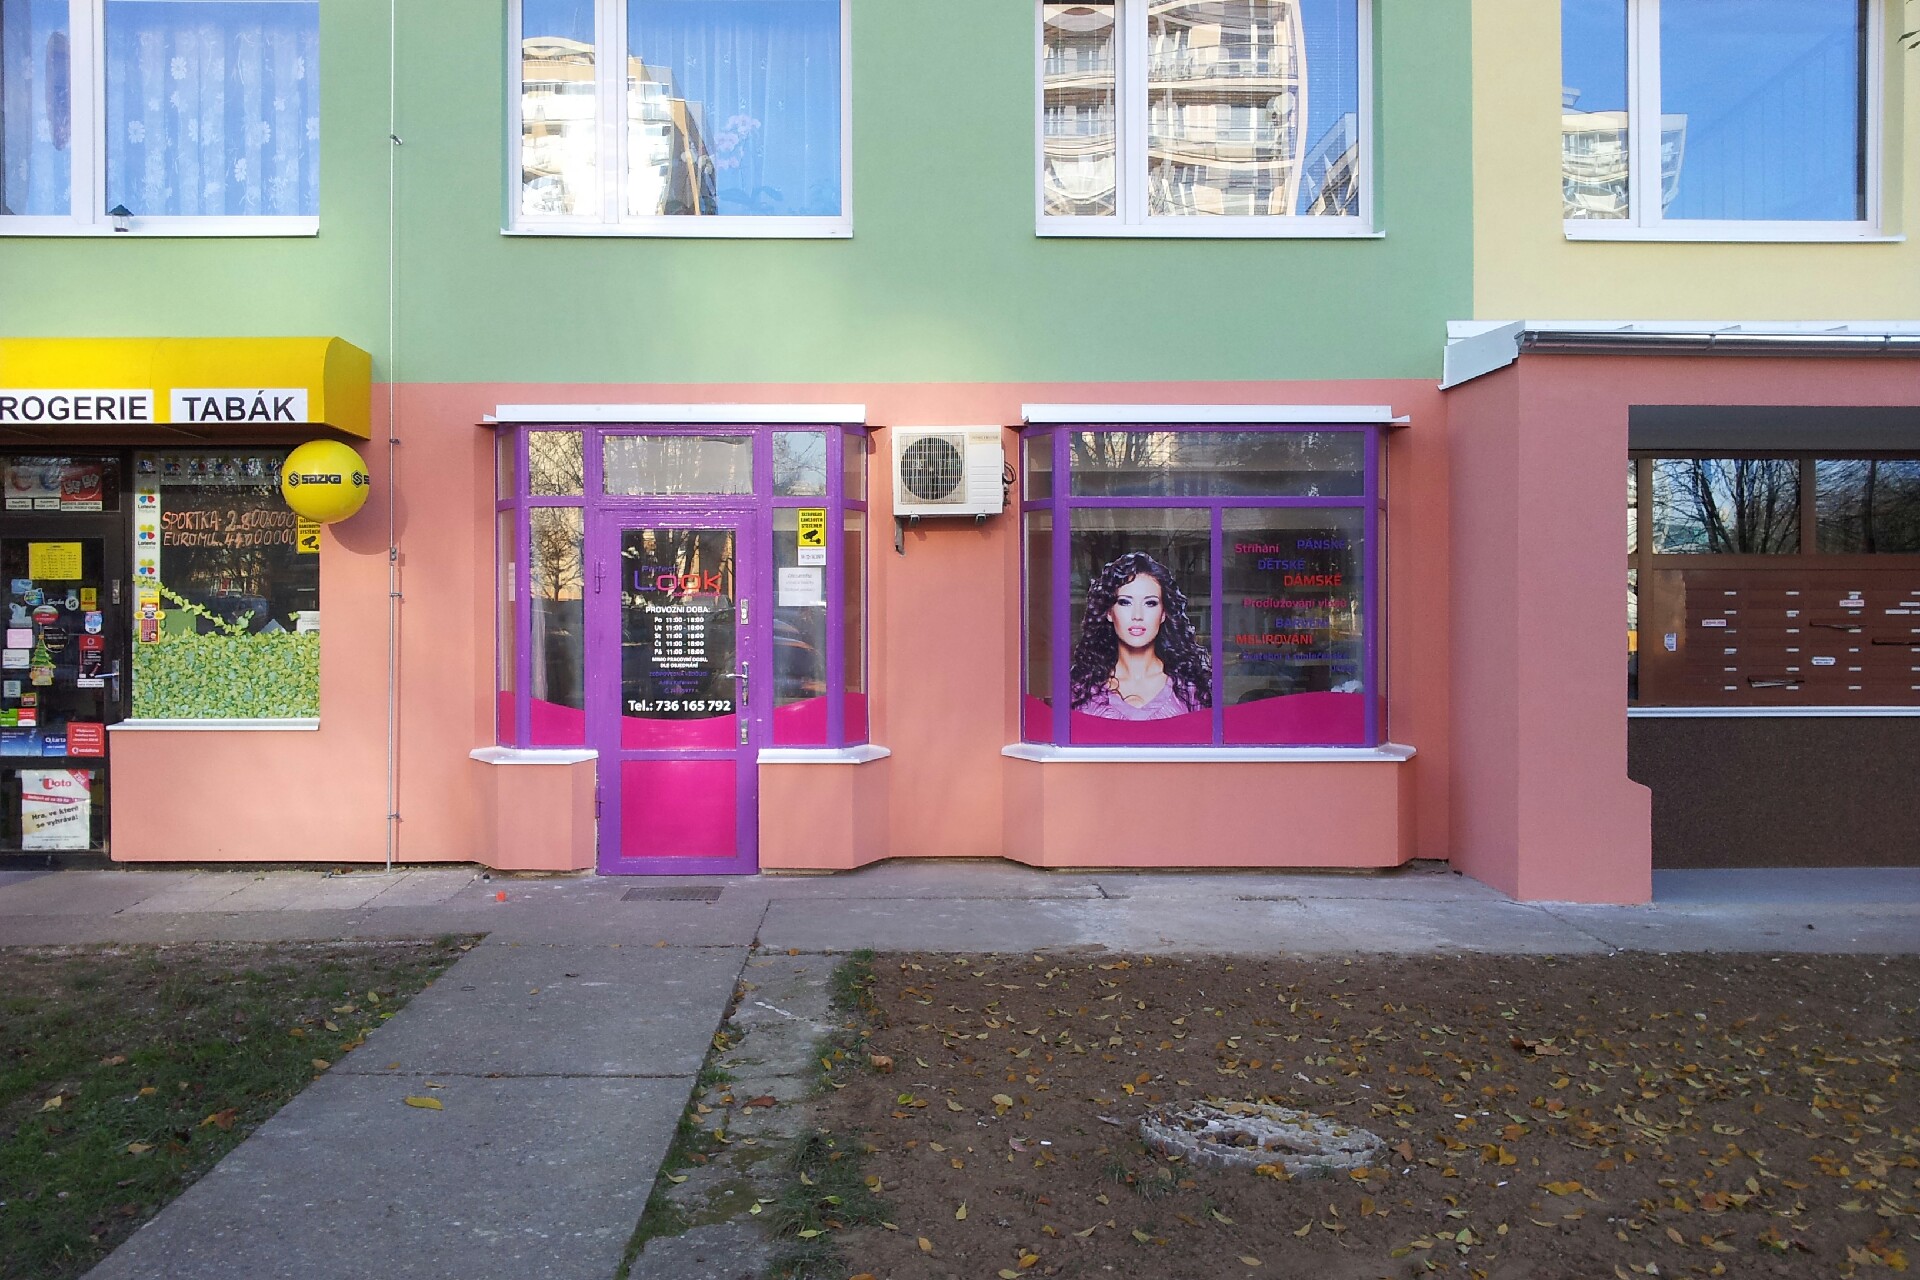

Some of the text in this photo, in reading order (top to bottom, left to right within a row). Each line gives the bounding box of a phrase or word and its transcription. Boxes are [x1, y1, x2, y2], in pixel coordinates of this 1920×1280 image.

[182, 389, 295, 421] TABÁK
[627, 700, 732, 712] Tel.: 736 165 792
